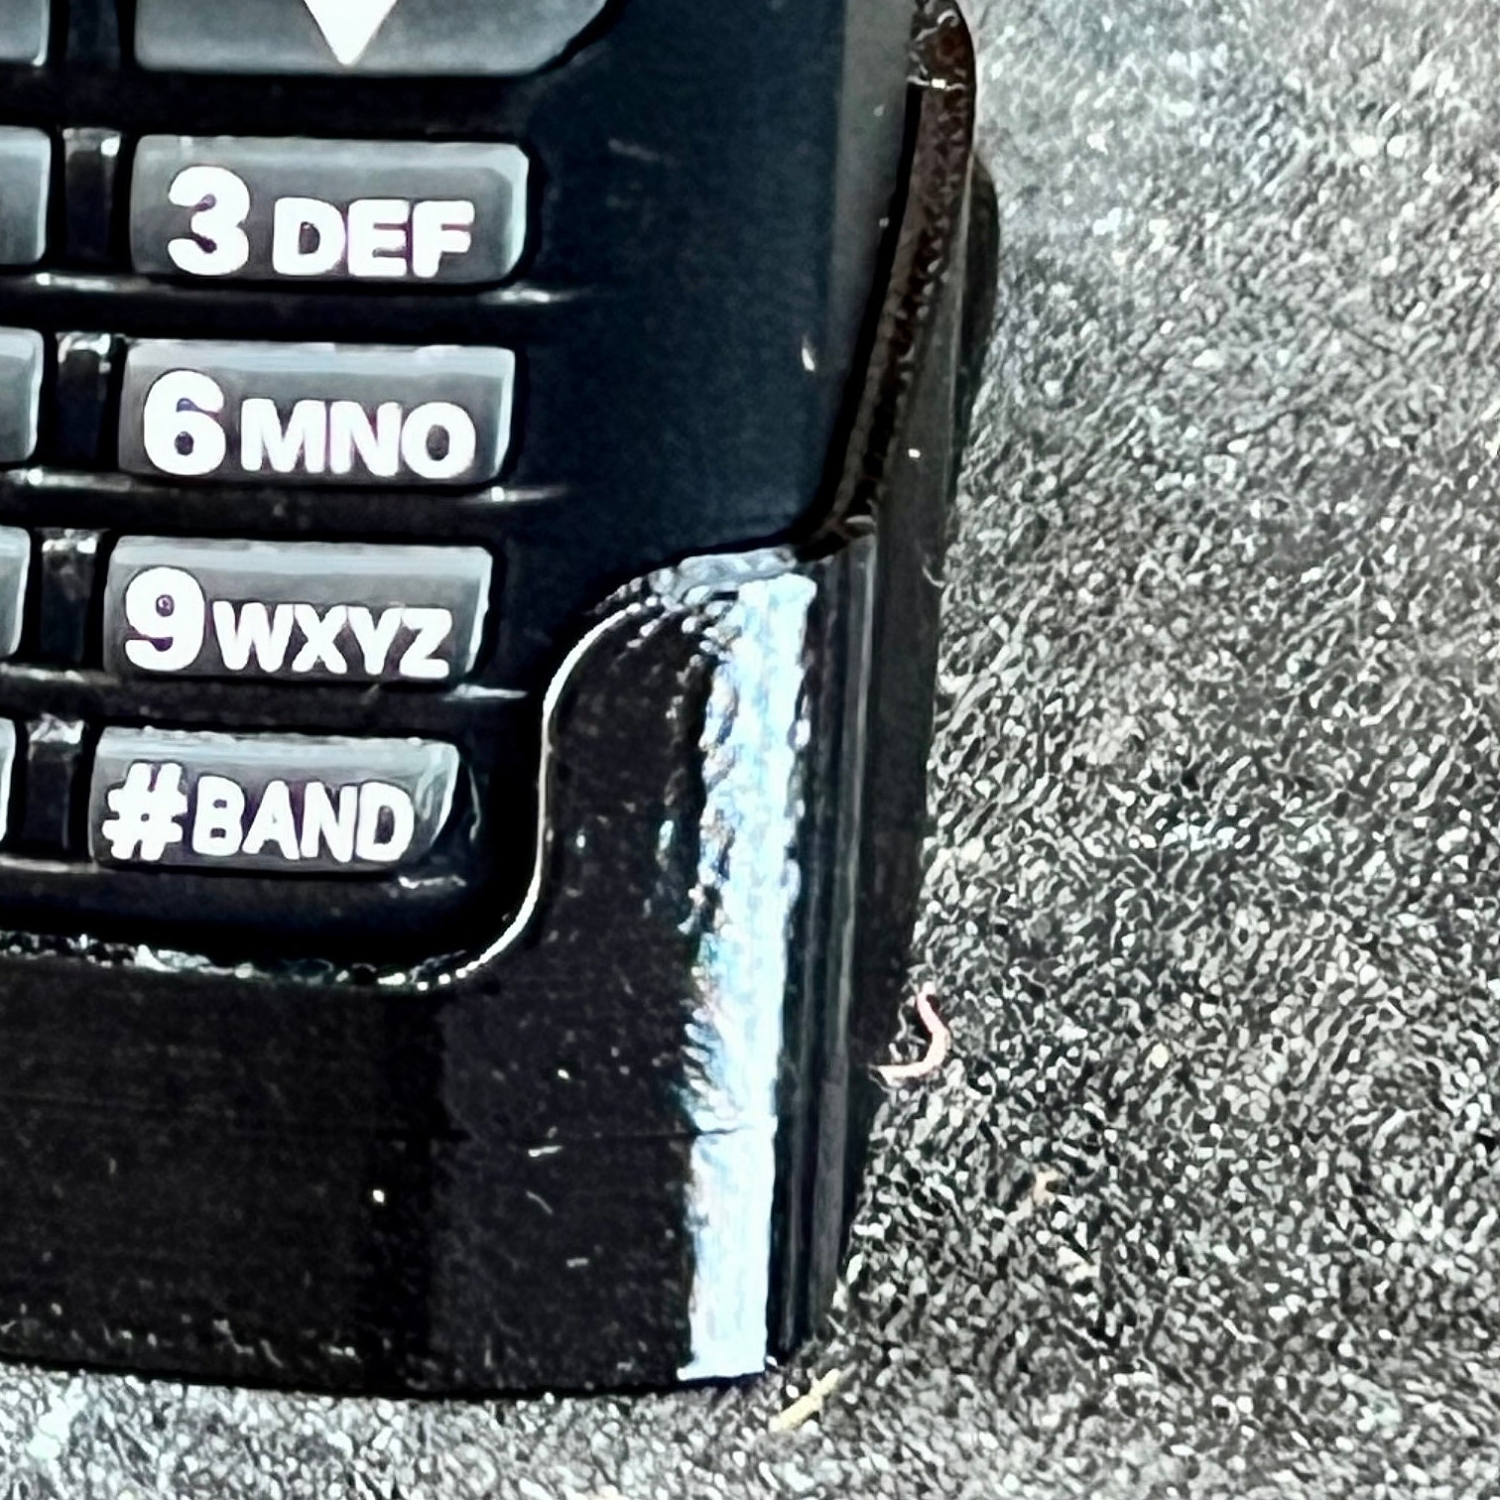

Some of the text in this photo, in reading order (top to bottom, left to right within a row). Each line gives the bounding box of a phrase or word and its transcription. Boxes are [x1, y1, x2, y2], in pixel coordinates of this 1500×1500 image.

[167, 165, 476, 279] 3 DEF
[142, 369, 477, 481] 6 MNO
[124, 565, 454, 680] 9 WXYZ
[191, 775, 416, 864] BAND
